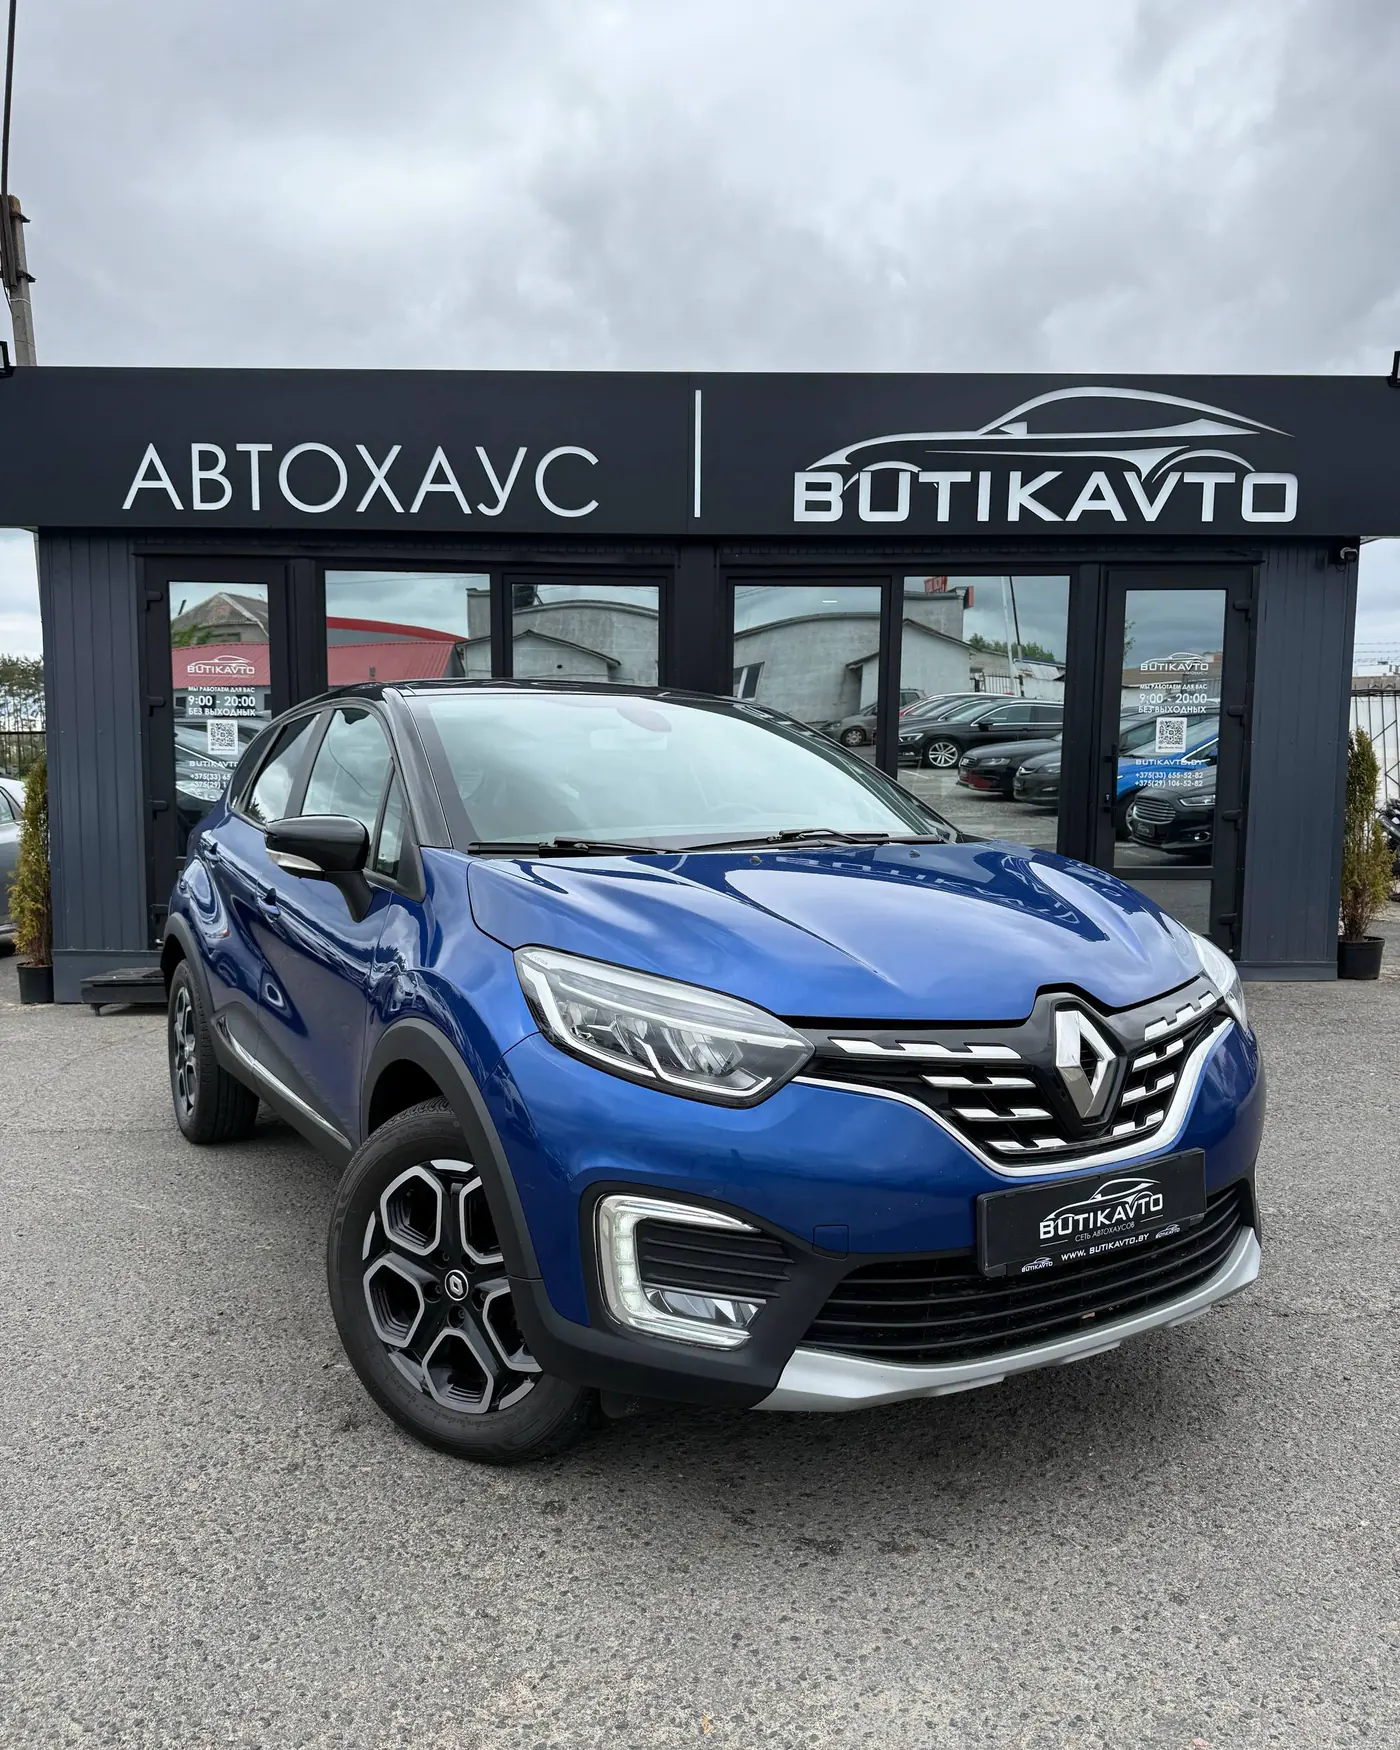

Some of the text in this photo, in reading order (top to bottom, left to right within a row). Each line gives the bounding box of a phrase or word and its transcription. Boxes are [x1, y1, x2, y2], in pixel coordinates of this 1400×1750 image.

[122, 442, 599, 517] АВТОХАУС
[793, 470, 1299, 522] BUTIKAVTO
[187, 665, 255, 674] BUTIKAVTO
[1140, 662, 1209, 671] BUTIKAVTO
[188, 695, 213, 706] 9:00
[224, 696, 256, 707] 20:00
[1140, 693, 1164, 704] 9:00
[1175, 693, 1207, 704] 20:00
[188, 707, 256, 717] БЕЗ ВЫХОДНЫХ
[1138, 705, 1207, 714] БЕЗ ВЫХОДНЫХ
[1135, 771, 1204, 780] +375(33) 655-52-82
[1135, 779, 1166, 788] +375(29)
[1039, 1193, 1163, 1240] BUTIKAVTO
[1074, 1221, 1136, 1242] СЕТЬ АВТОХАУСОВ
[1061, 1232, 1150, 1261] WWW. BUTIKAVTO.BY
